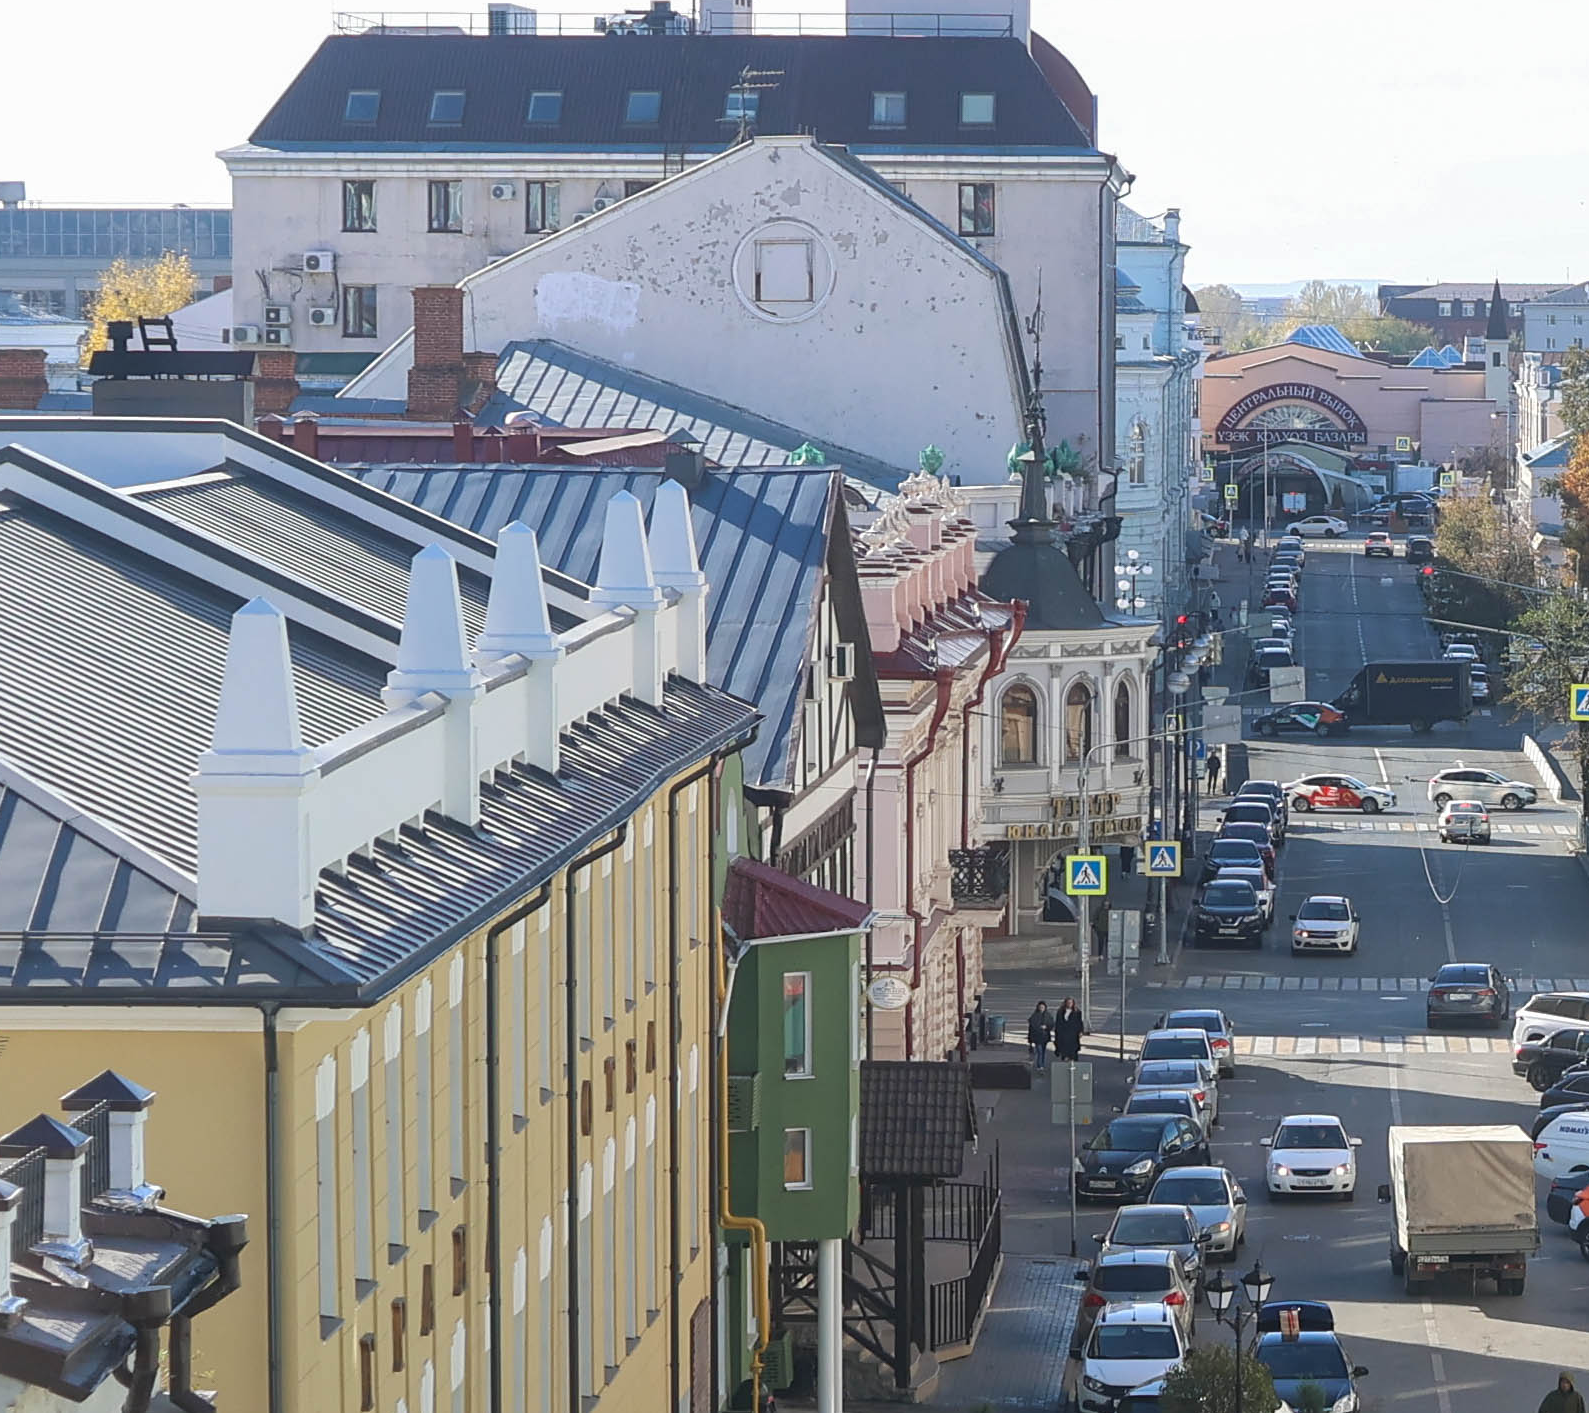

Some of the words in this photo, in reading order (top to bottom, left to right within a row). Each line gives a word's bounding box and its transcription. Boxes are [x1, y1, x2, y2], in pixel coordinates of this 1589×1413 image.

[1223, 385, 1314, 428] ЦЕНТРАЛЬНЫЙ
[1318, 391, 1360, 428] РЫНОК
[1256, 431, 1308, 442] КОЛХОЗ
[1314, 431, 1366, 442] БАЗАРЫ
